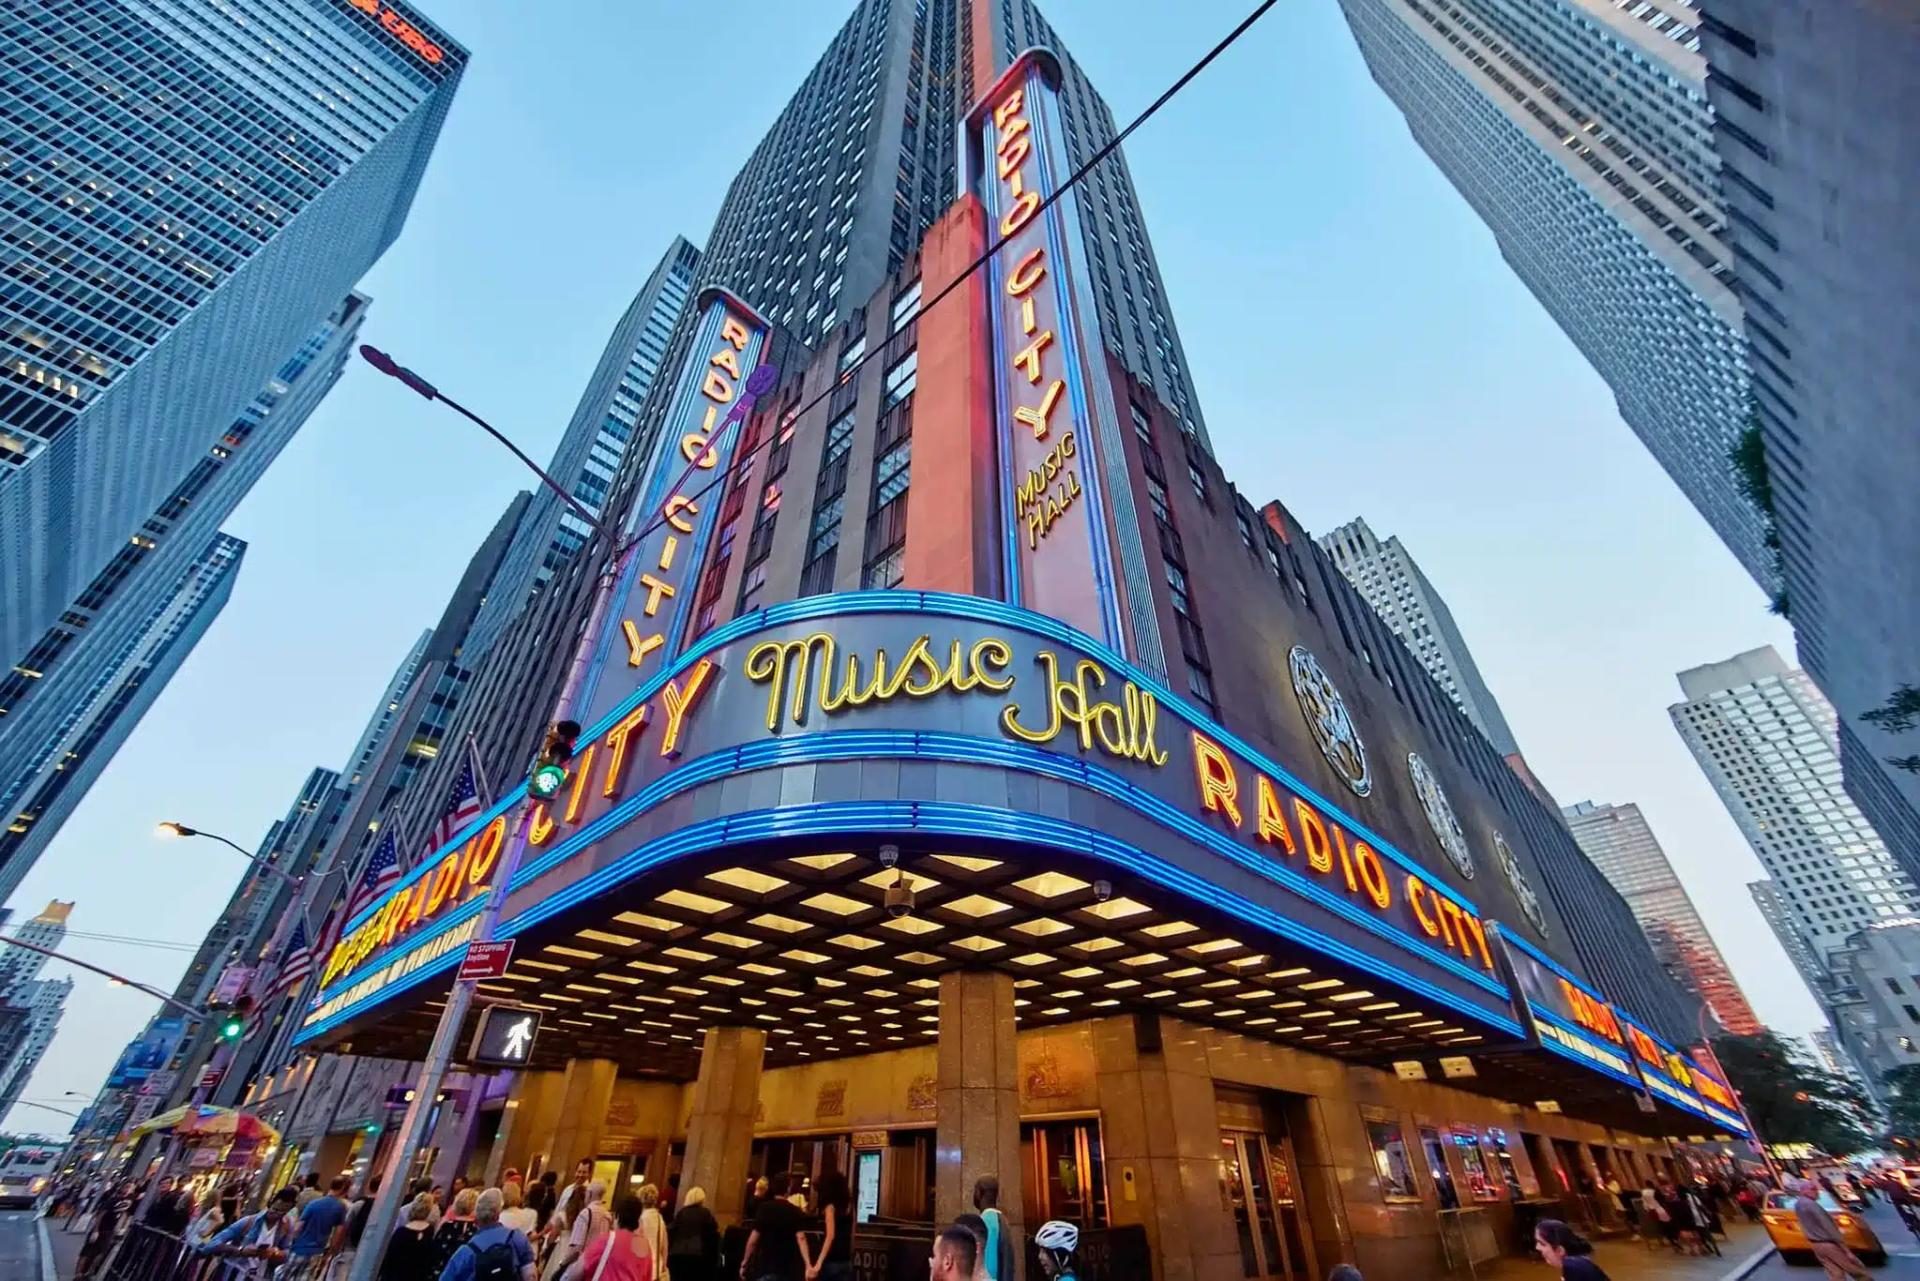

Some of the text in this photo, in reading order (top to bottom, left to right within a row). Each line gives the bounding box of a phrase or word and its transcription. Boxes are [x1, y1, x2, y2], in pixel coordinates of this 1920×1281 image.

[380, 8, 444, 65] UBS
[995, 89, 1067, 441] RADIO CITY
[622, 317, 750, 668] RADIO CITY
[1015, 431, 1077, 519] MUSIC
[1026, 469, 1082, 552] HALL
[1000, 650, 1169, 768] Hall
[380, 815, 506, 947] RADIO
[1191, 728, 1494, 971] RADIO CITY
